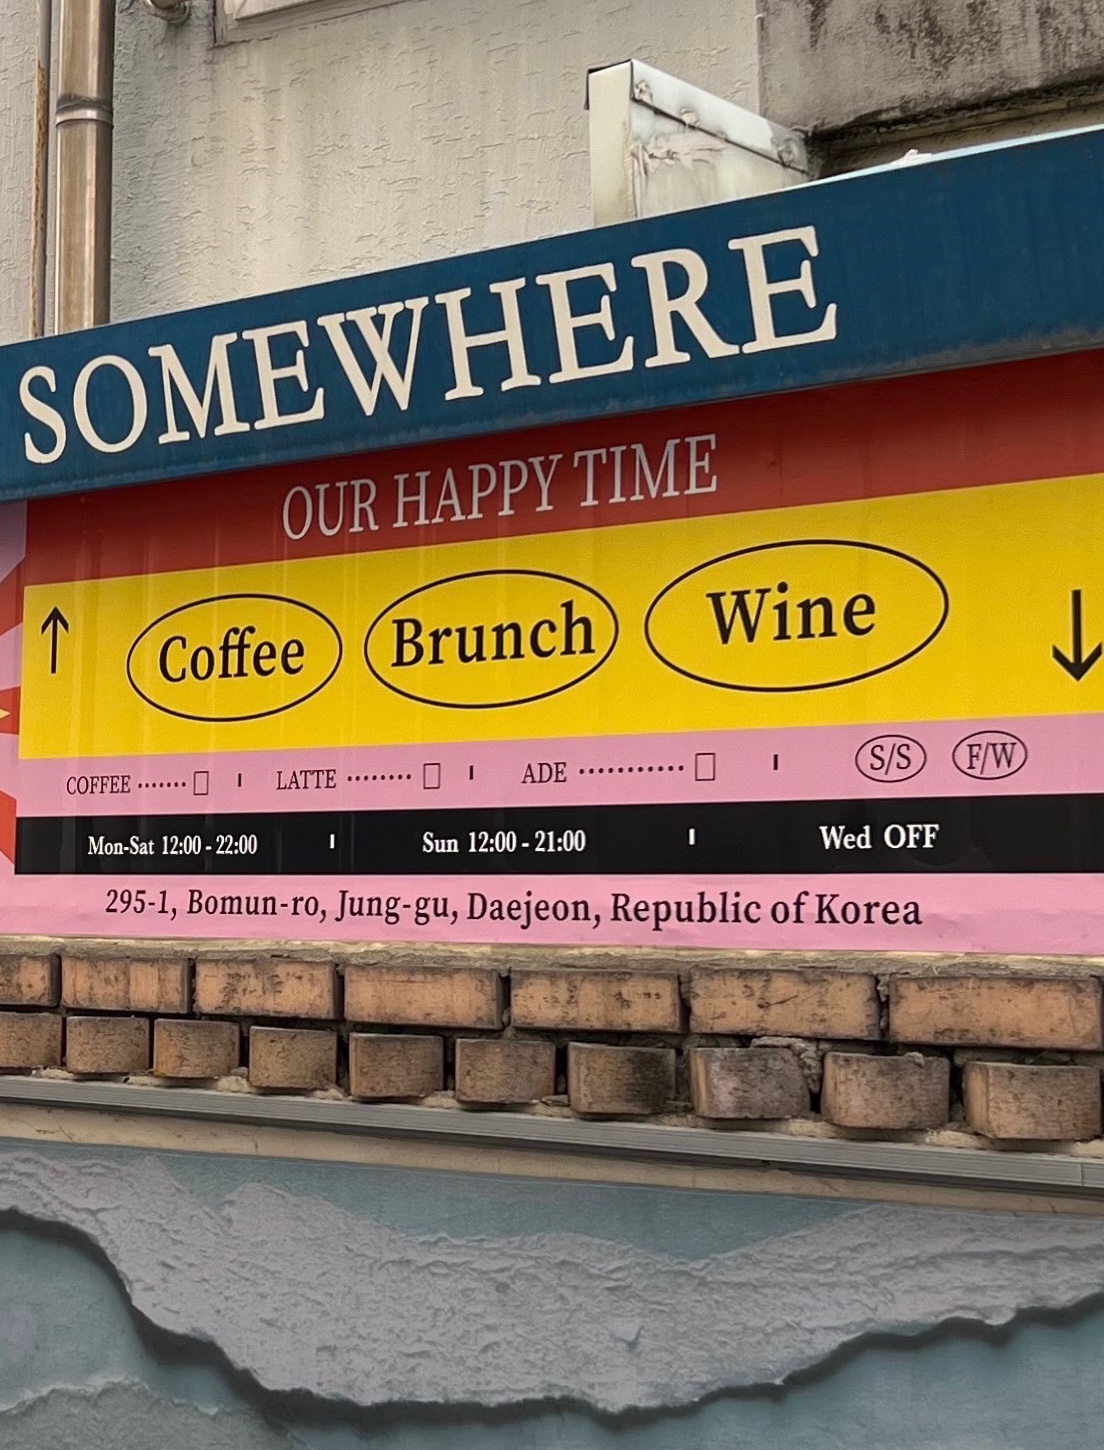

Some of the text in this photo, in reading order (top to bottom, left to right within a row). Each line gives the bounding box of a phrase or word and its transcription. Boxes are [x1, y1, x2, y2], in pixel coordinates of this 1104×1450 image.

[19, 226, 837, 464] SOMEWHERE
[282, 434, 718, 540] OUR HAPPY TIME
[705, 581, 876, 645] Wine
[390, 600, 596, 669] Brunch
[158, 626, 306, 683] Coffee
[520, 761, 568, 785] ADE
[869, 742, 912, 776] S/S
[966, 741, 1017, 775] F/W
[66, 774, 132, 795] COFFEE
[275, 768, 338, 791] LATTE
[87, 835, 155, 856] Mon-Sat
[161, 835, 202, 855] 12:00
[215, 834, 258, 855] 22:00
[422, 831, 460, 853] Sun
[468, 830, 517, 853] 12:00
[534, 829, 586, 853] 21:00
[818, 823, 940, 850] Wed OFF
[105, 889, 924, 932] 295-1, Bomun-ro, Jung-gu, Daejeon, Republic of Korea
